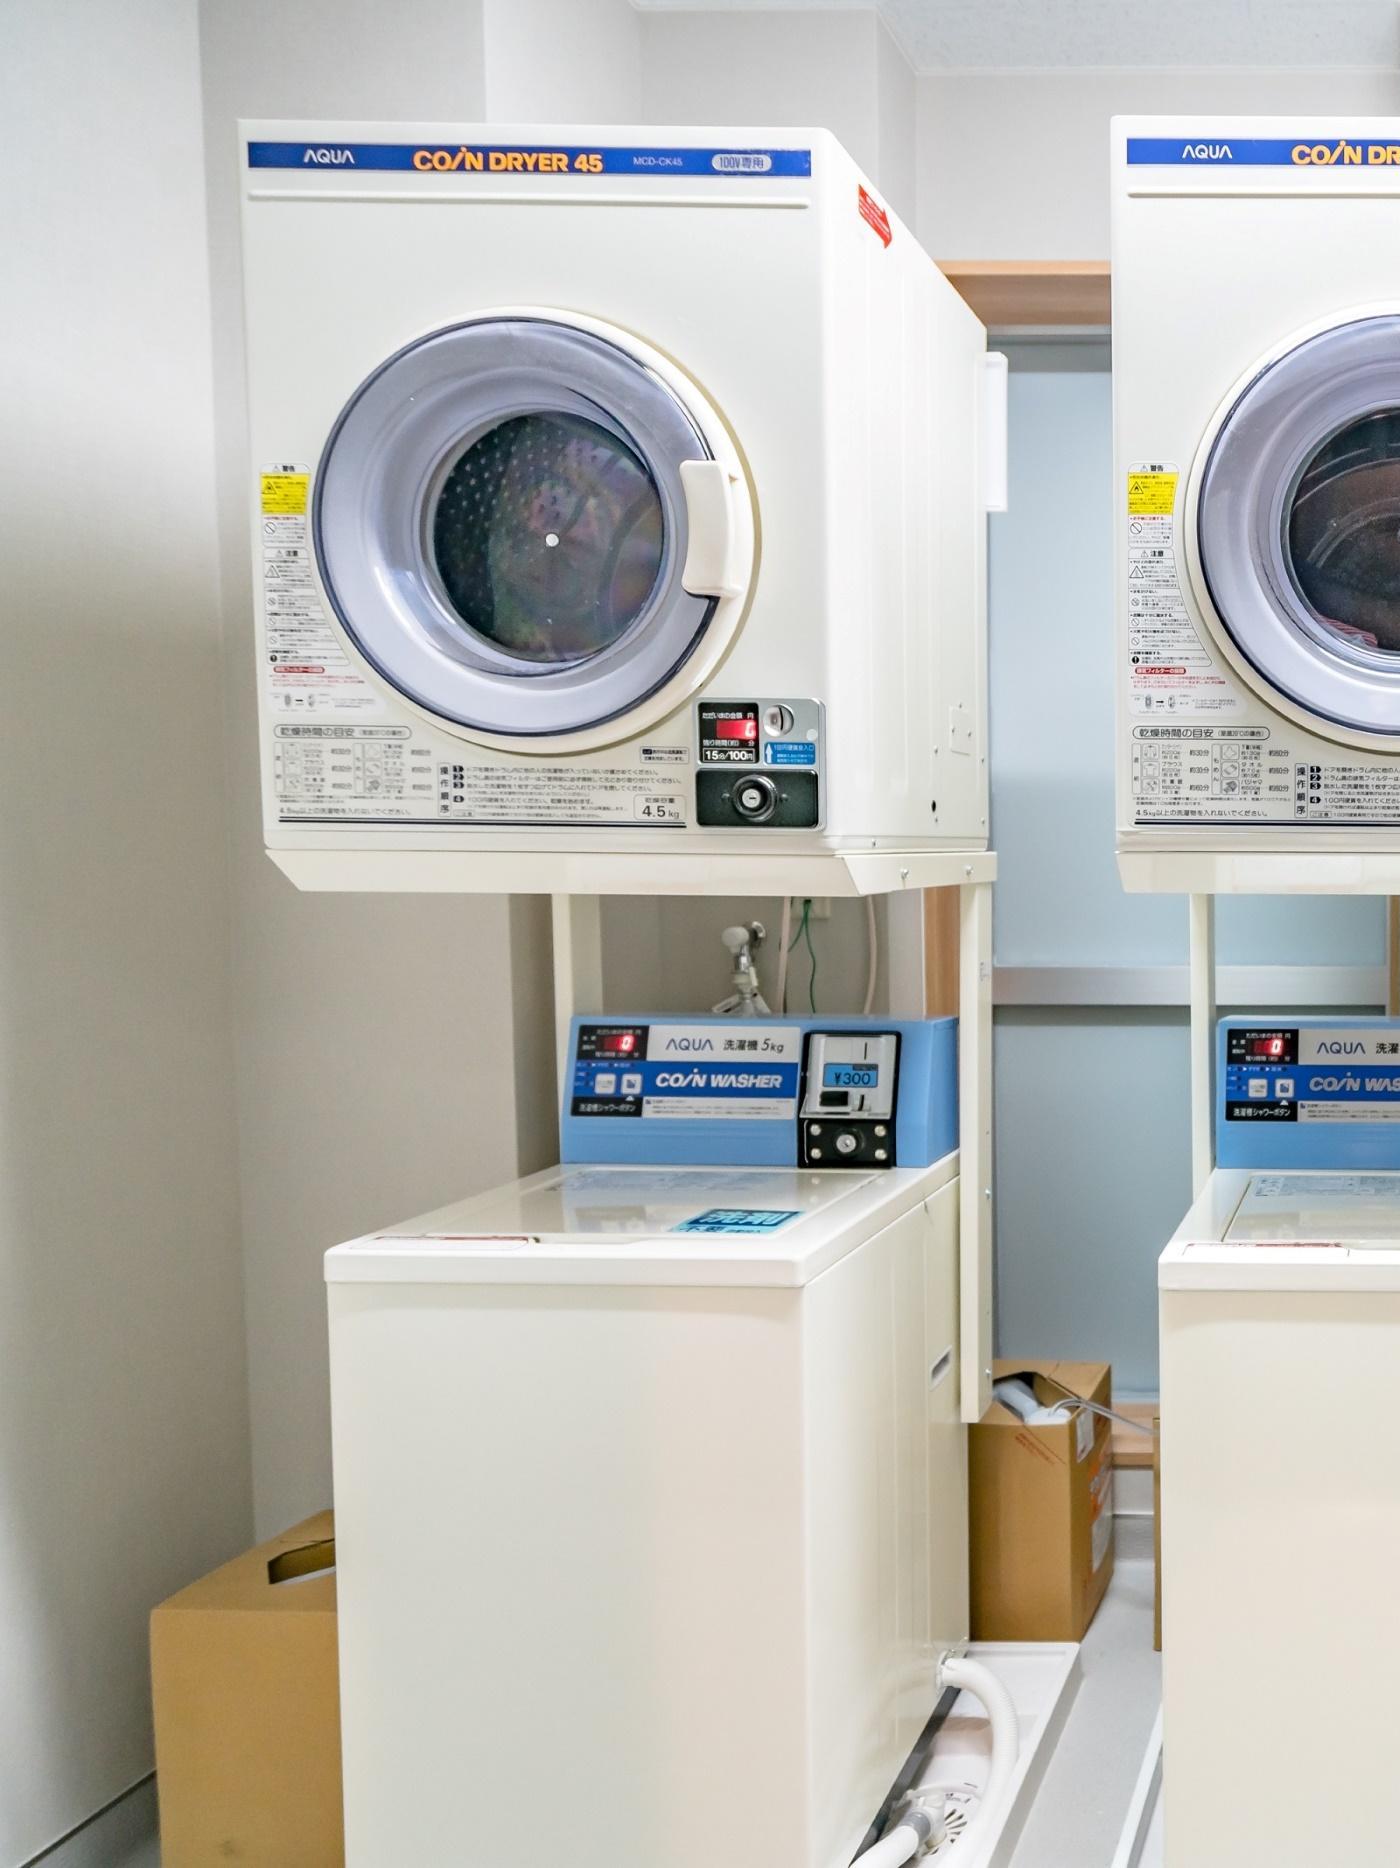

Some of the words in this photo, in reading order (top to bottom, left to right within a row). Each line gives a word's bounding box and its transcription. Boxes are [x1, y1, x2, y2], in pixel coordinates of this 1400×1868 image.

[304, 149, 354, 164] AQUA
[1182, 145, 1232, 159] AQUA
[489, 152, 568, 172] DRYER
[574, 153, 603, 173] 45
[633, 157, 682, 166] MCD-CK45
[1140, 729, 1213, 737] 乾燥時間の目安
[642, 806, 665, 817] 4.5
[669, 810, 679, 819] kg
[621, 1037, 632, 1049] 0
[666, 1038, 713, 1051] AQUA
[723, 1039, 757, 1051] 洗濯機
[1271, 1040, 1281, 1053] 0
[1317, 1042, 1366, 1054] AQUA
[711, 1075, 782, 1088] WASHER
[834, 1072, 871, 1085] ¥300
